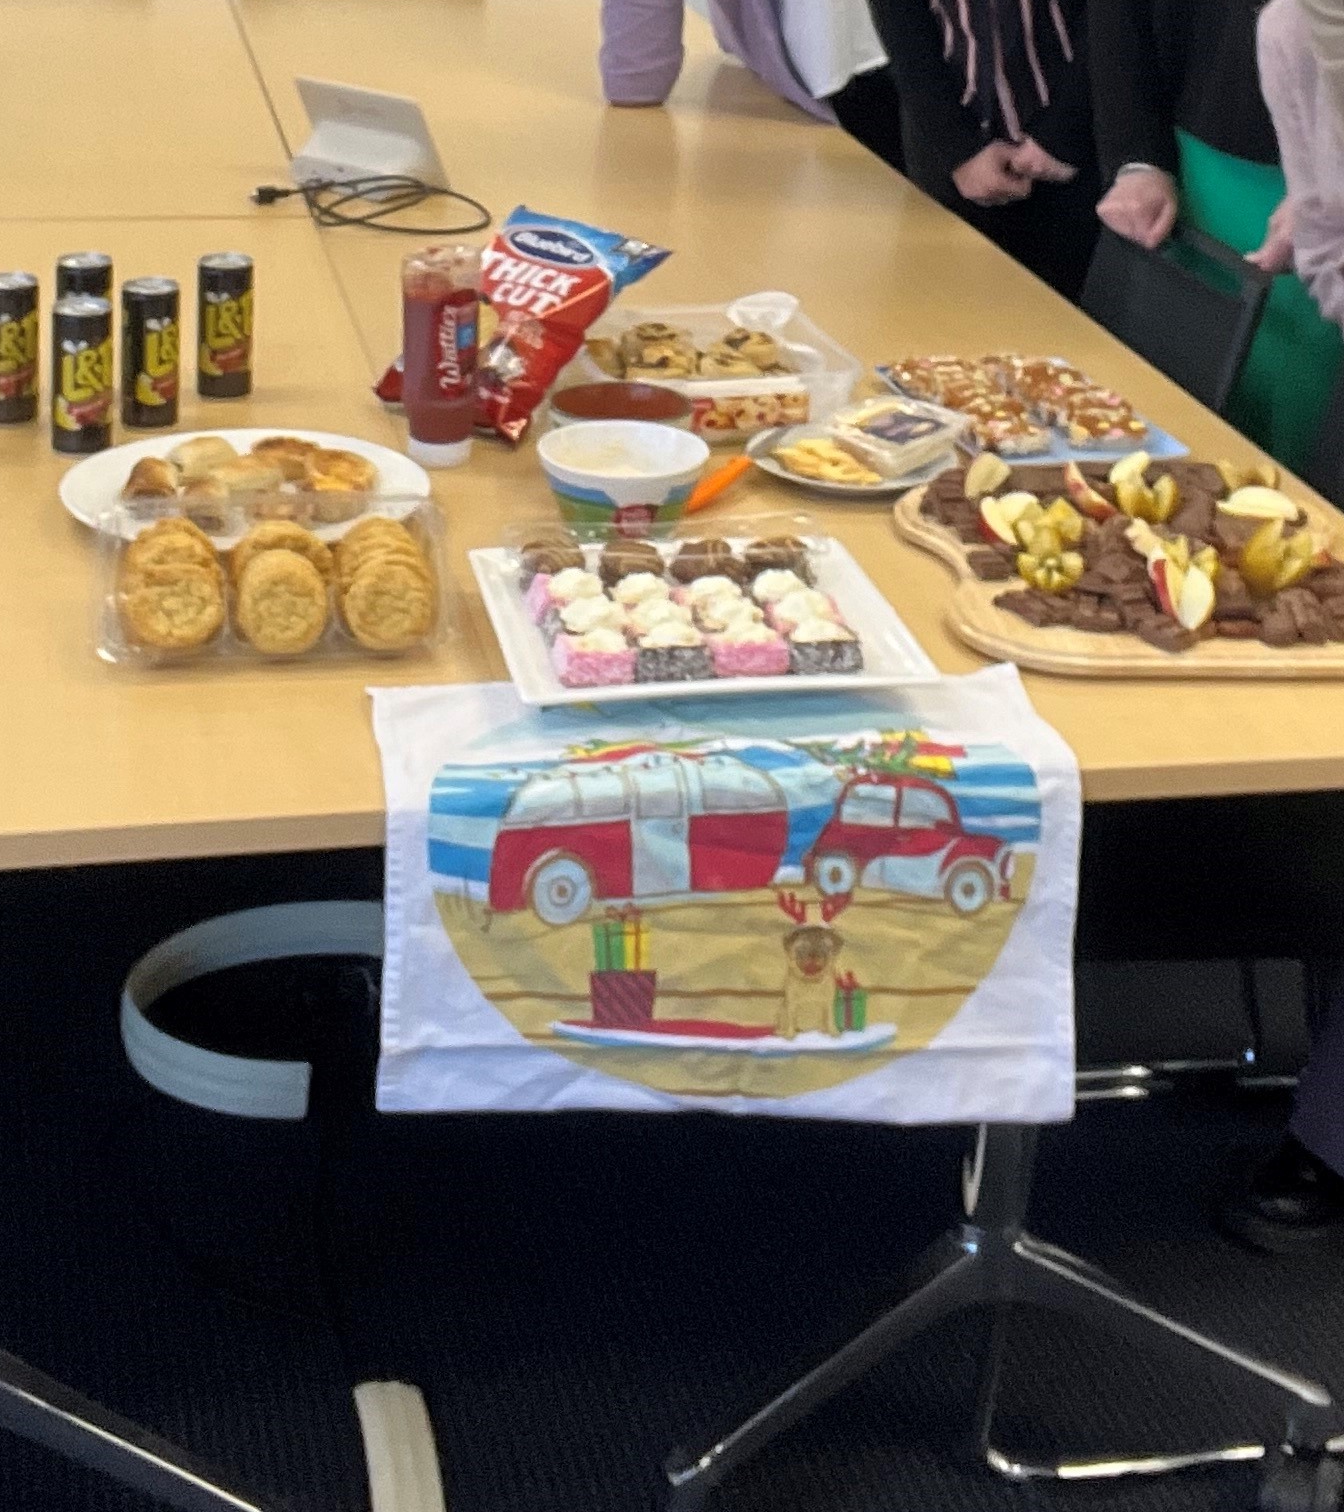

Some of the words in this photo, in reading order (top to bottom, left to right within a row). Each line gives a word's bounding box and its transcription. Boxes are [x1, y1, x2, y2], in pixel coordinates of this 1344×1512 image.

[481, 248, 582, 296] THICK
[492, 284, 562, 316] CUT
[146, 322, 178, 377] L&
